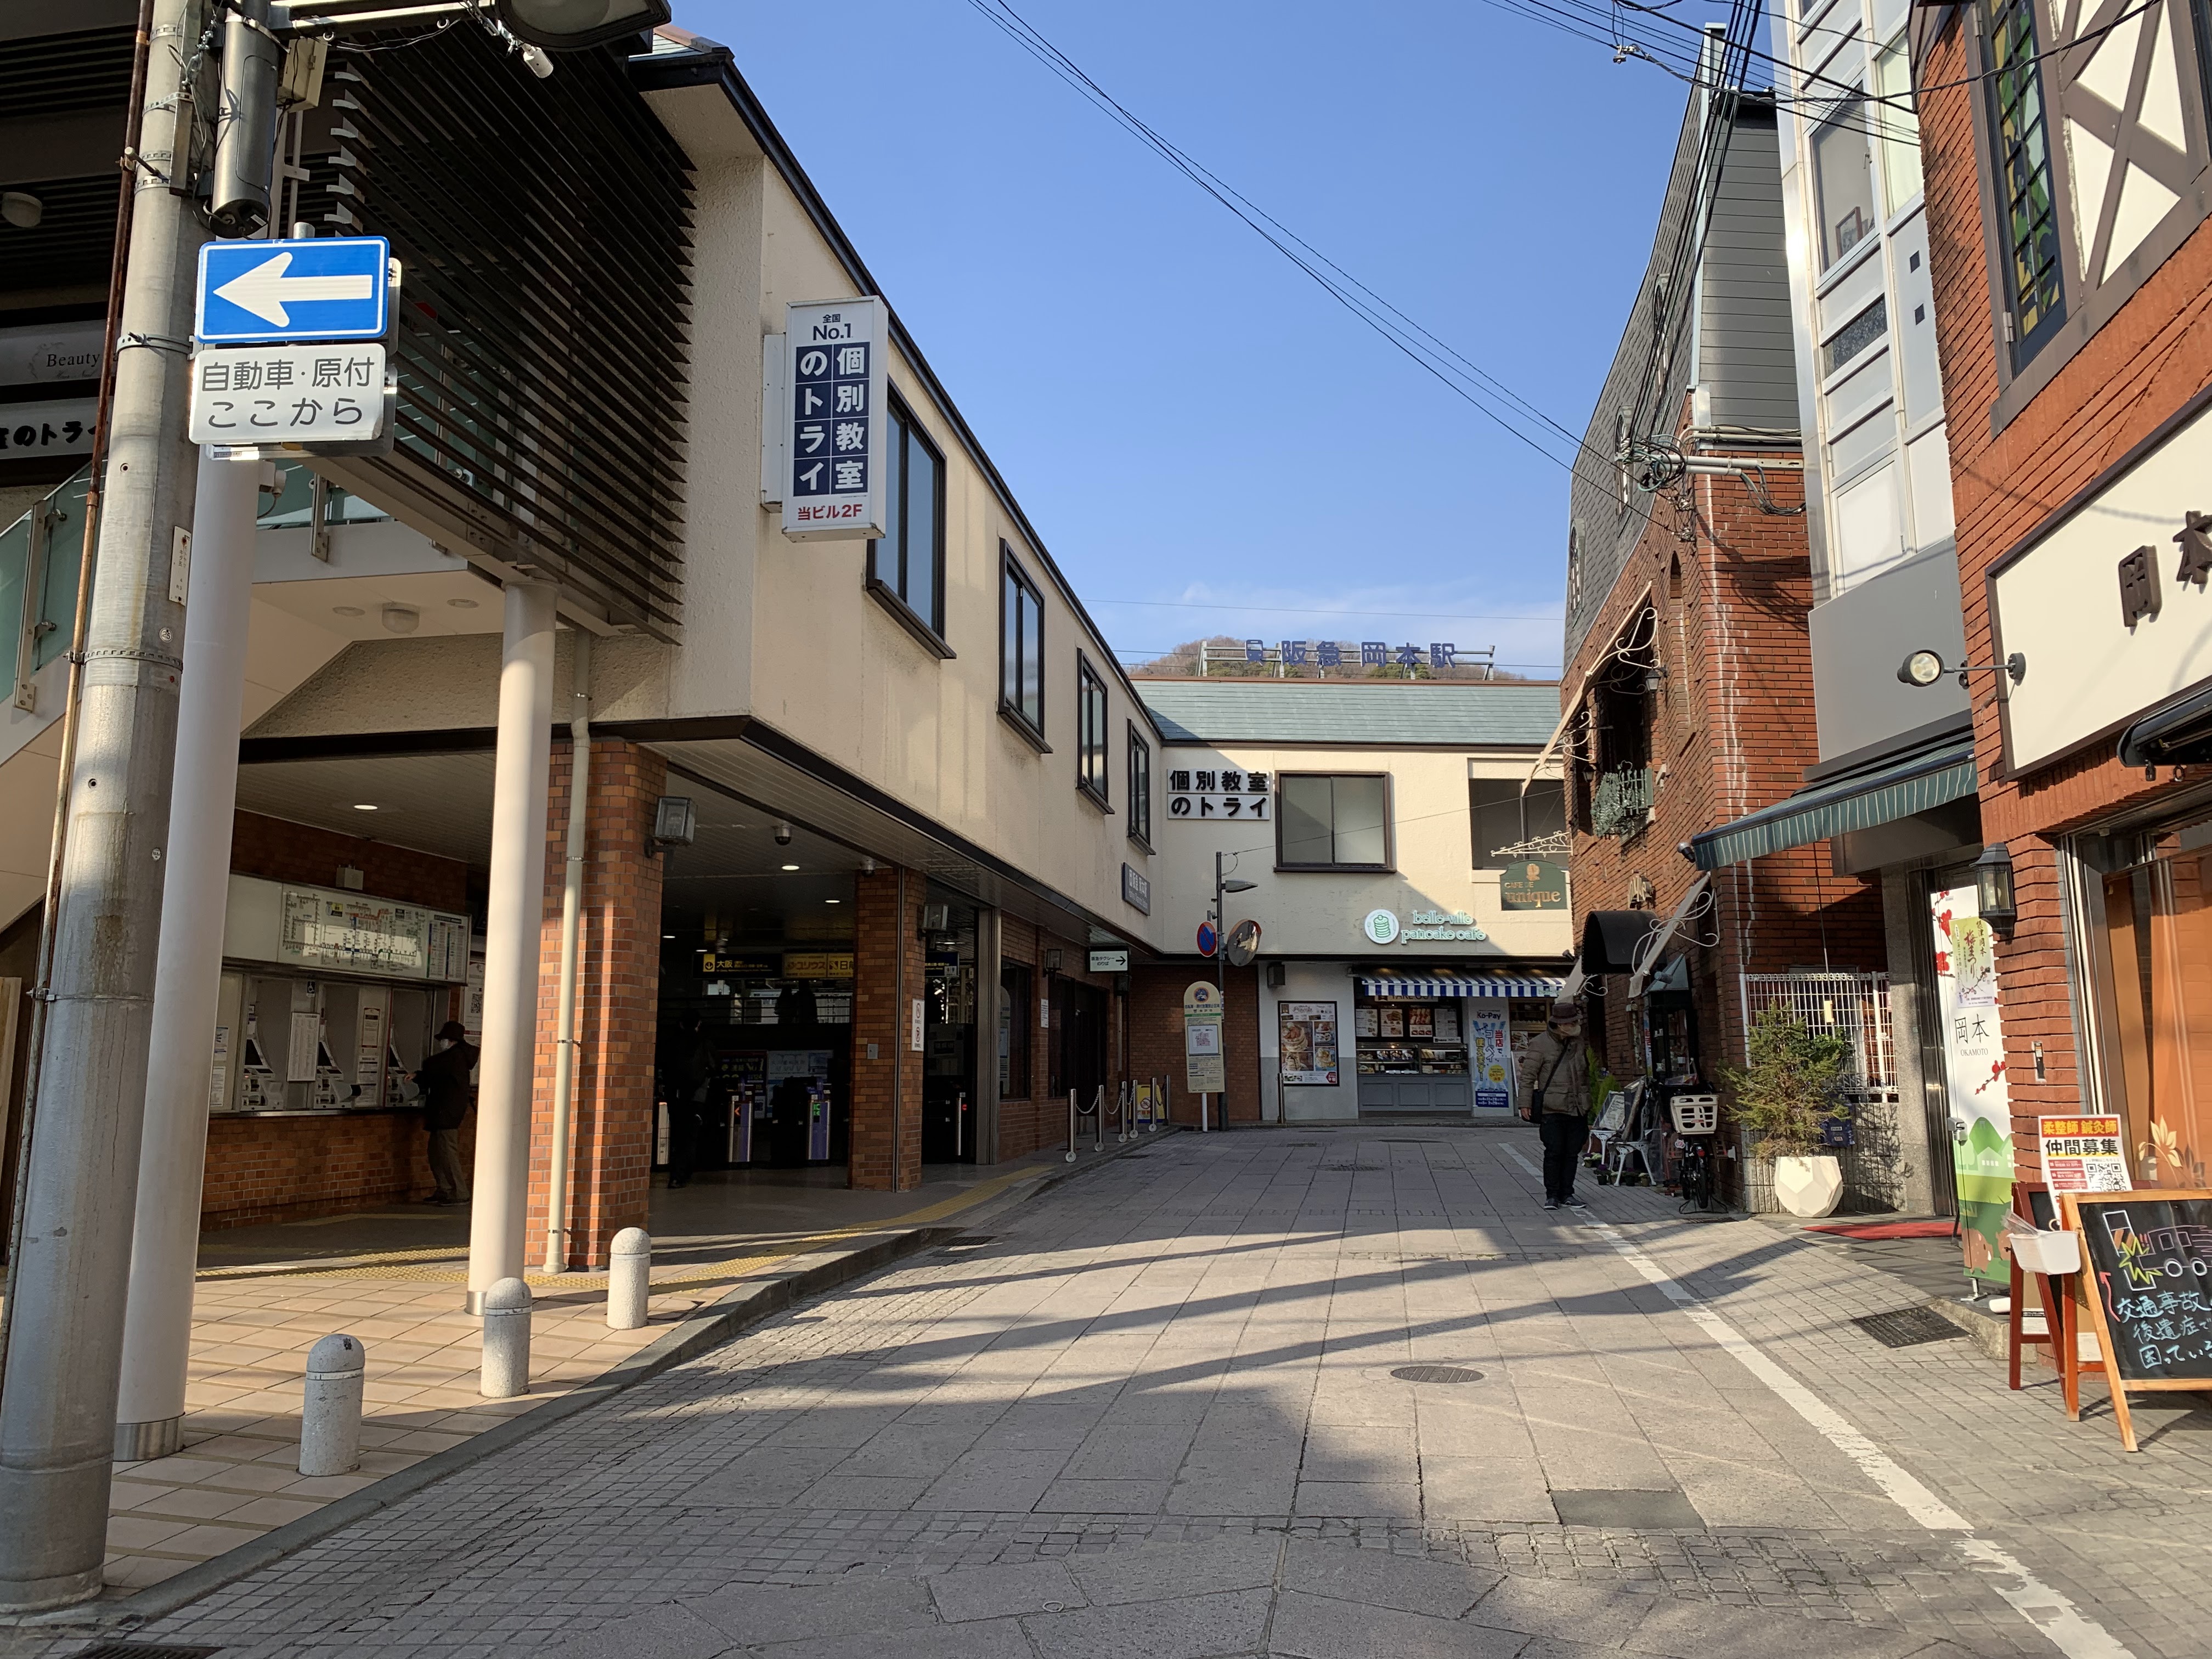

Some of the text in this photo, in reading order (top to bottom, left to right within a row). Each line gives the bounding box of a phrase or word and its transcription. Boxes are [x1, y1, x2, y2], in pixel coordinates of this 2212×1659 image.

[823, 314, 840, 323] 全国
[813, 323, 852, 340] No.1
[46, 353, 100, 367] Beauty
[202, 357, 375, 391] 自動車・原付
[208, 397, 362, 428] ここから
[799, 351, 828, 490] のトライ
[836, 347, 865, 489] 個別教室
[797, 504, 863, 520] 当ビル2F
[1170, 770, 1268, 792] 個別教室
[1171, 796, 1267, 817] のトライ
[1505, 889, 1561, 907] unique
[1413, 910, 1473, 924] belle-ville
[1401, 926, 1455, 944] pancake
[1477, 1012, 1501, 1020] Ko-Pay
[1954, 1013, 1990, 1044] 岡本
[2043, 1120, 2117, 1135] 柔整師 鍼灸師
[2045, 1138, 2119, 1156] 仲間募集
[2117, 1290, 2212, 1323] 交通事故
